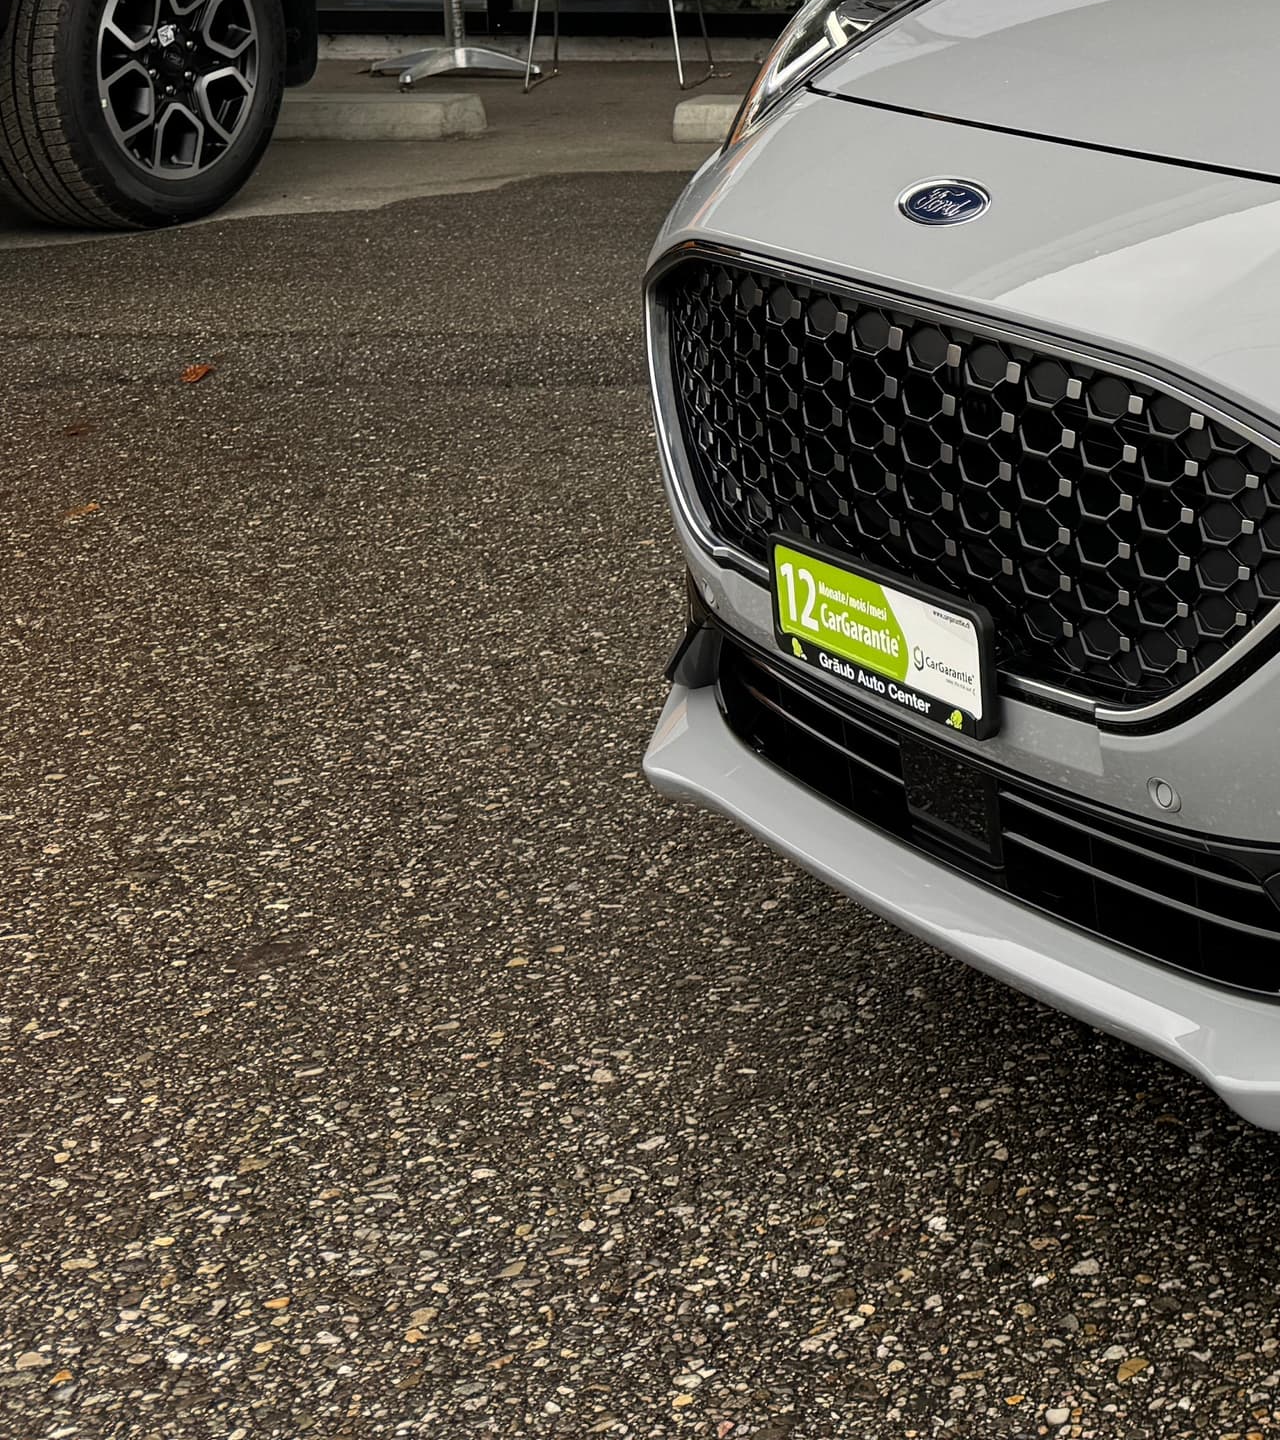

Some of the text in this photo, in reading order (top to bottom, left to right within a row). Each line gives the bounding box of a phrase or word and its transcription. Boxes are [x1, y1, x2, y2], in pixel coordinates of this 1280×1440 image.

[914, 187, 972, 217] Ford
[779, 562, 820, 633] 12
[818, 652, 855, 681] Gräub
[857, 665, 886, 694] Auto
[887, 683, 931, 715] Center
